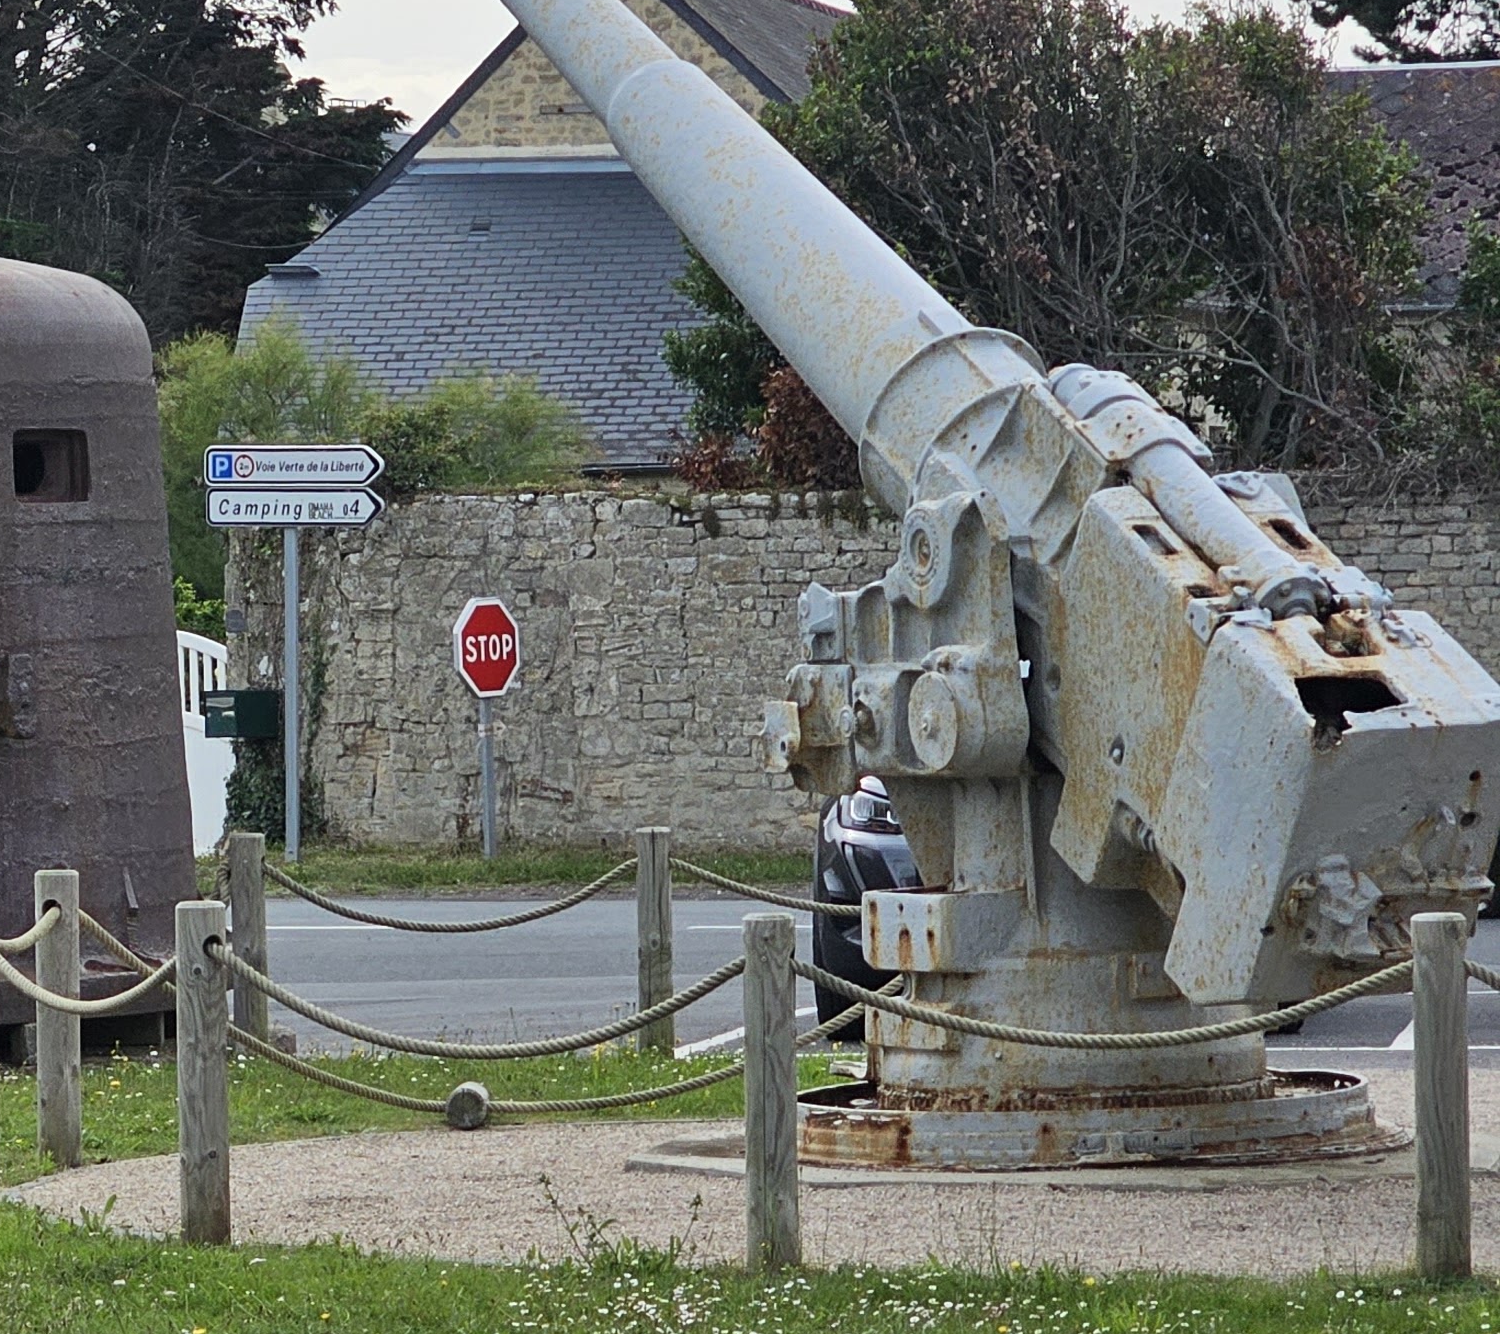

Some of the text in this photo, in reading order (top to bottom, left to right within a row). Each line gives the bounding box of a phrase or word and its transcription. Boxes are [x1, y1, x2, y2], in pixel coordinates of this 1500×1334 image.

[215, 457, 228, 476] P
[255, 460, 365, 472] Voie Verte de la Liberté
[219, 499, 302, 520] Camping
[465, 633, 513, 663] STOP
